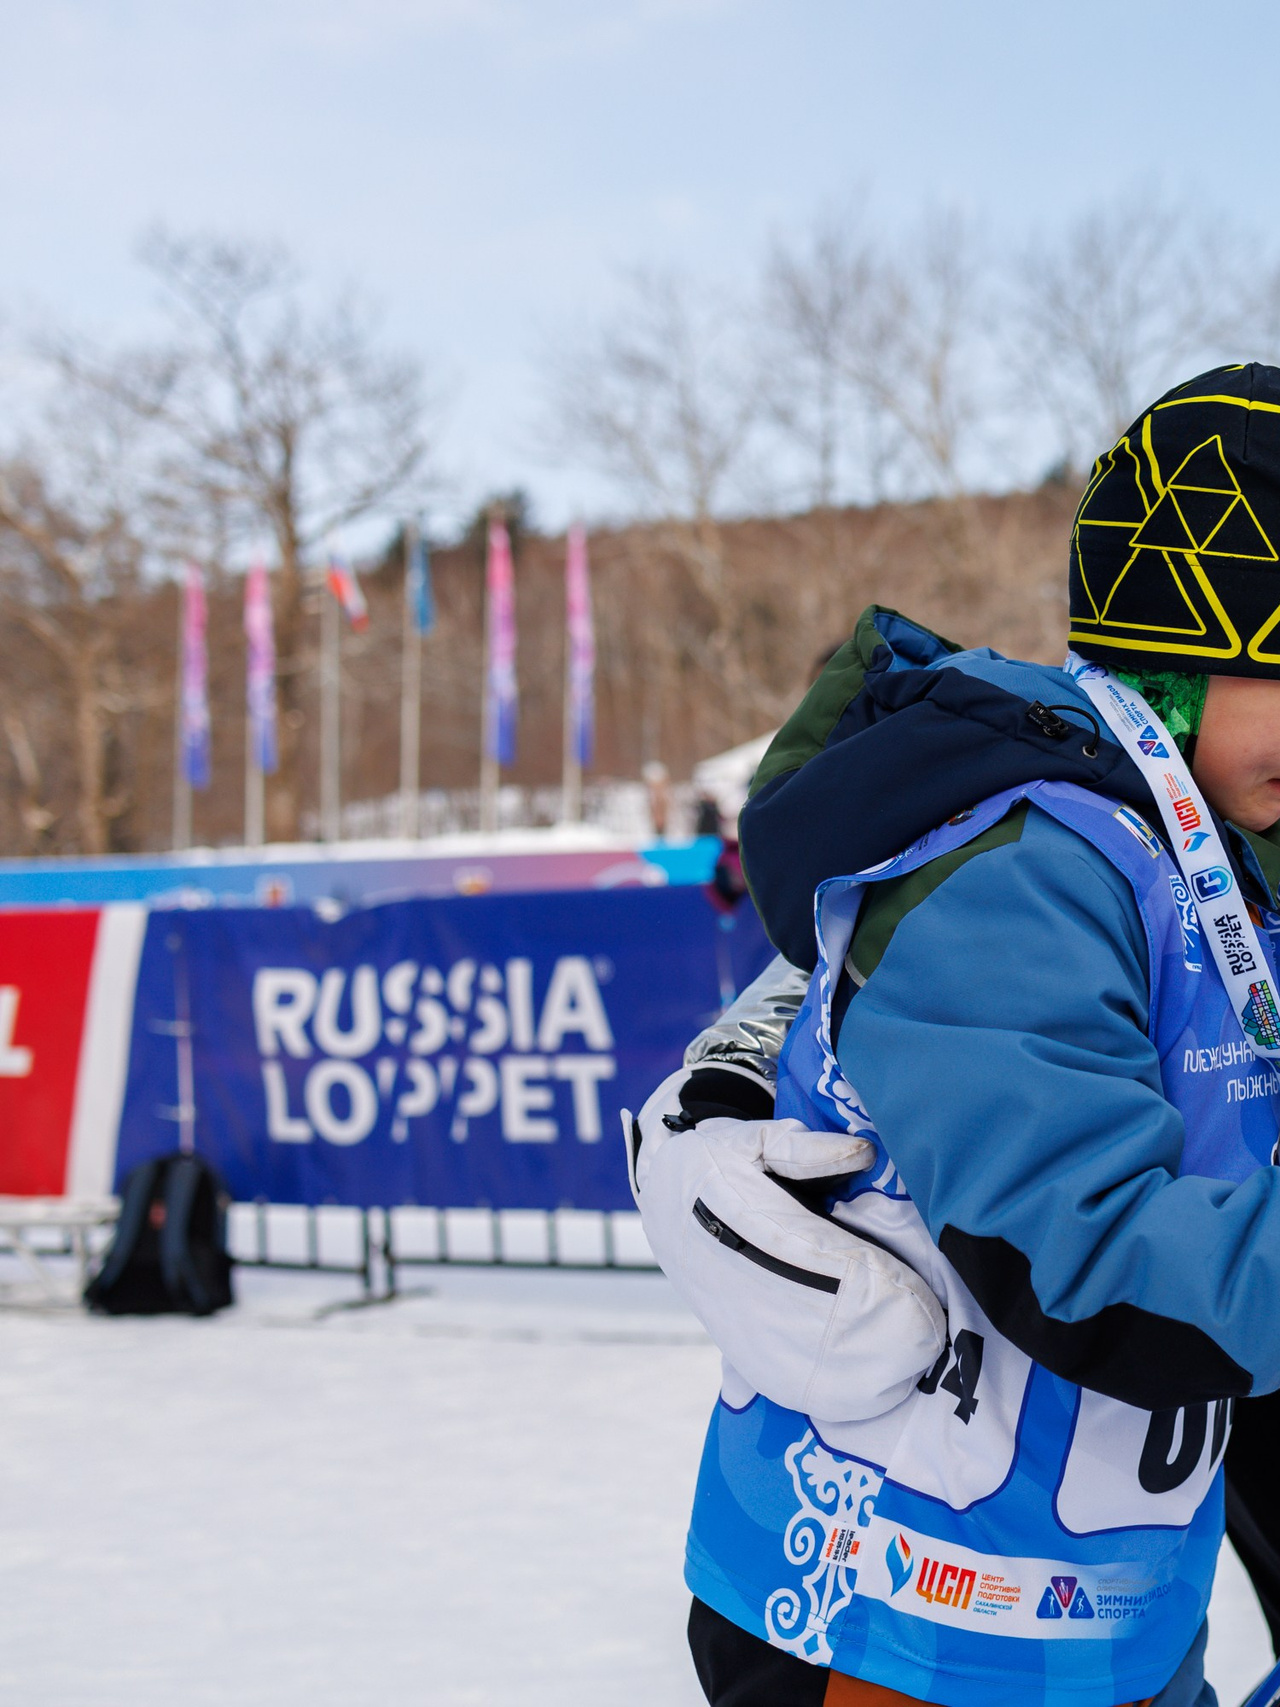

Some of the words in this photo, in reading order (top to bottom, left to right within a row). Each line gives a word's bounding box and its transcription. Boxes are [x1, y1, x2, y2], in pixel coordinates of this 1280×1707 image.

[1213, 914, 1245, 976] RUSSIA
[1226, 914, 1257, 973] LOPPET
[253, 956, 615, 1058] RUSSIA
[1183, 1040, 1256, 1073] МЕЖДУНА
[261, 1055, 617, 1145] LOPPET
[916, 1556, 977, 1610] ЦСП
[977, 1591, 1020, 1603] ПОДГОТОВКИ
[980, 1582, 1021, 1594] СПОРТИВНОЙ
[981, 1573, 1005, 1584] ЦЕНТР
[1097, 1608, 1146, 1619] СПОРТА
